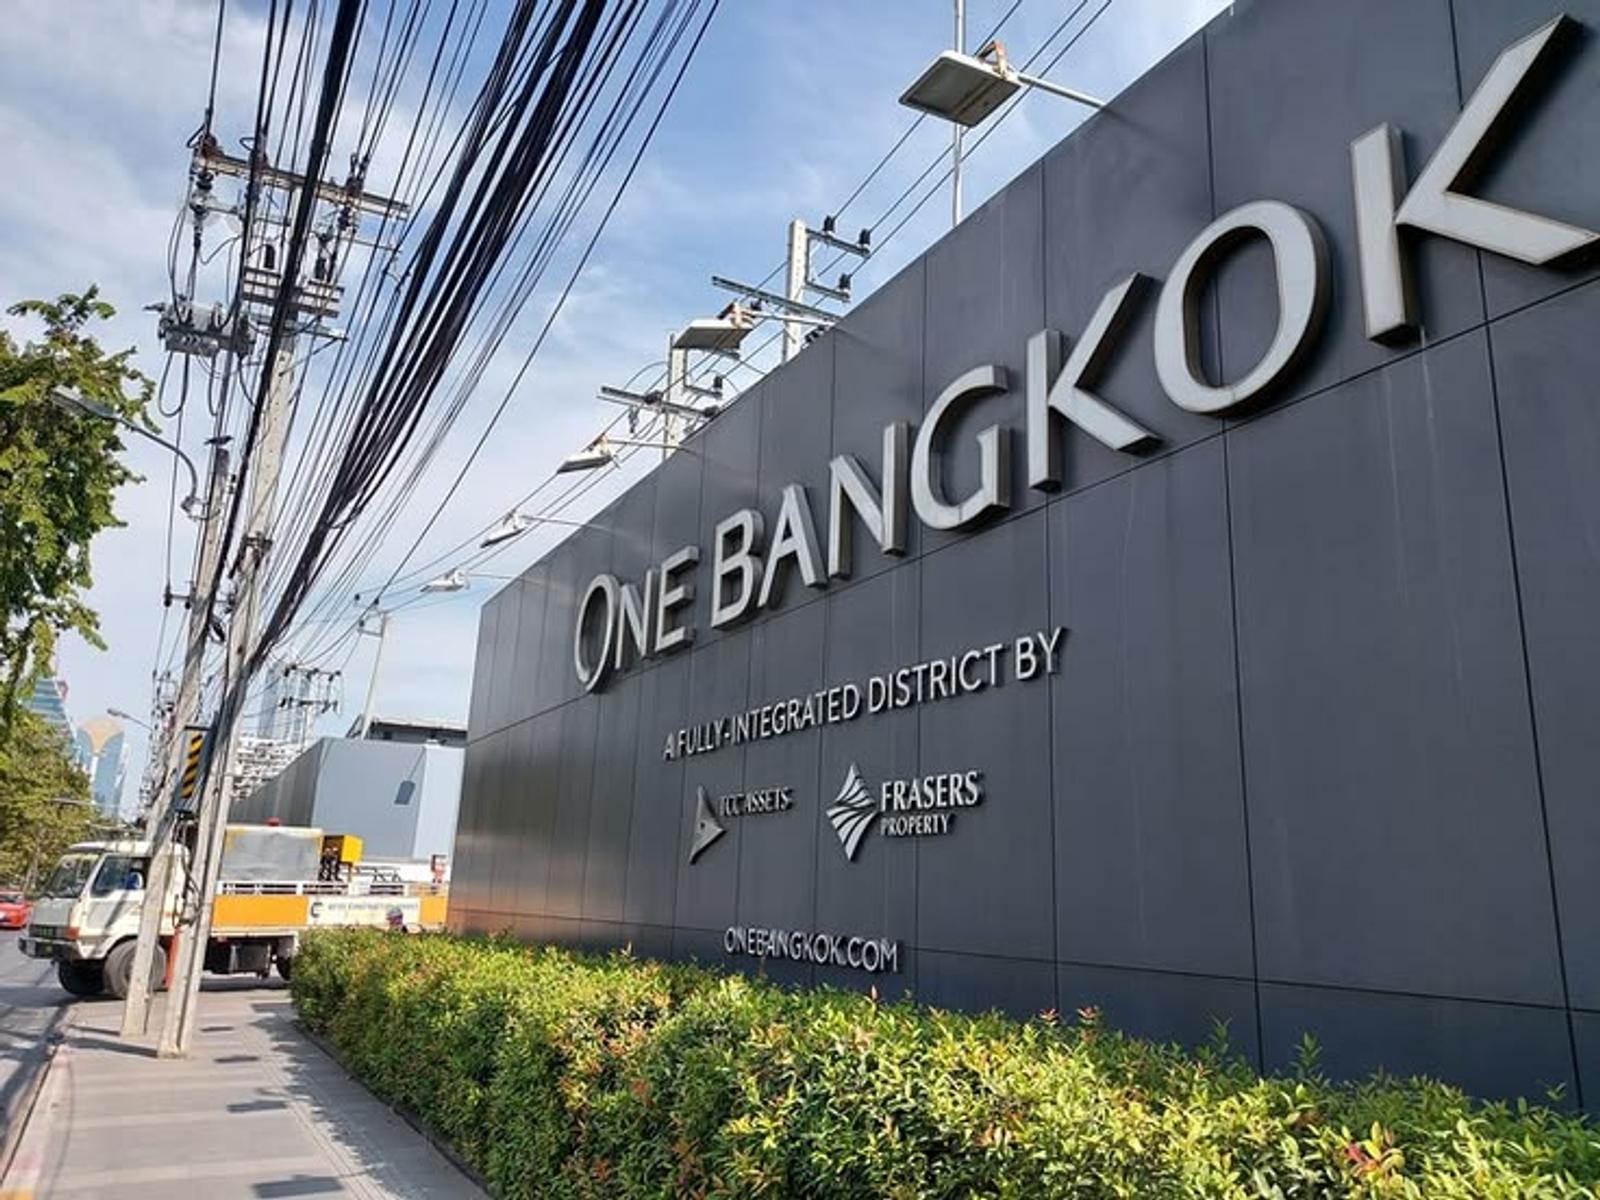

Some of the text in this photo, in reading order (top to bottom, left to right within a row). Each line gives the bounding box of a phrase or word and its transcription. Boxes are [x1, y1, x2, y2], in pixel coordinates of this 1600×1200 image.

[573, 12, 1600, 694] ONE BANGKOK
[662, 626, 1064, 760] A FULLY-INTEGRATED DISTRICT BY
[745, 786, 791, 813] ASSETS
[880, 770, 981, 812] FRASERS
[880, 814, 952, 836] PROPERTY
[724, 926, 898, 972] ONEBANGKOK.COM
